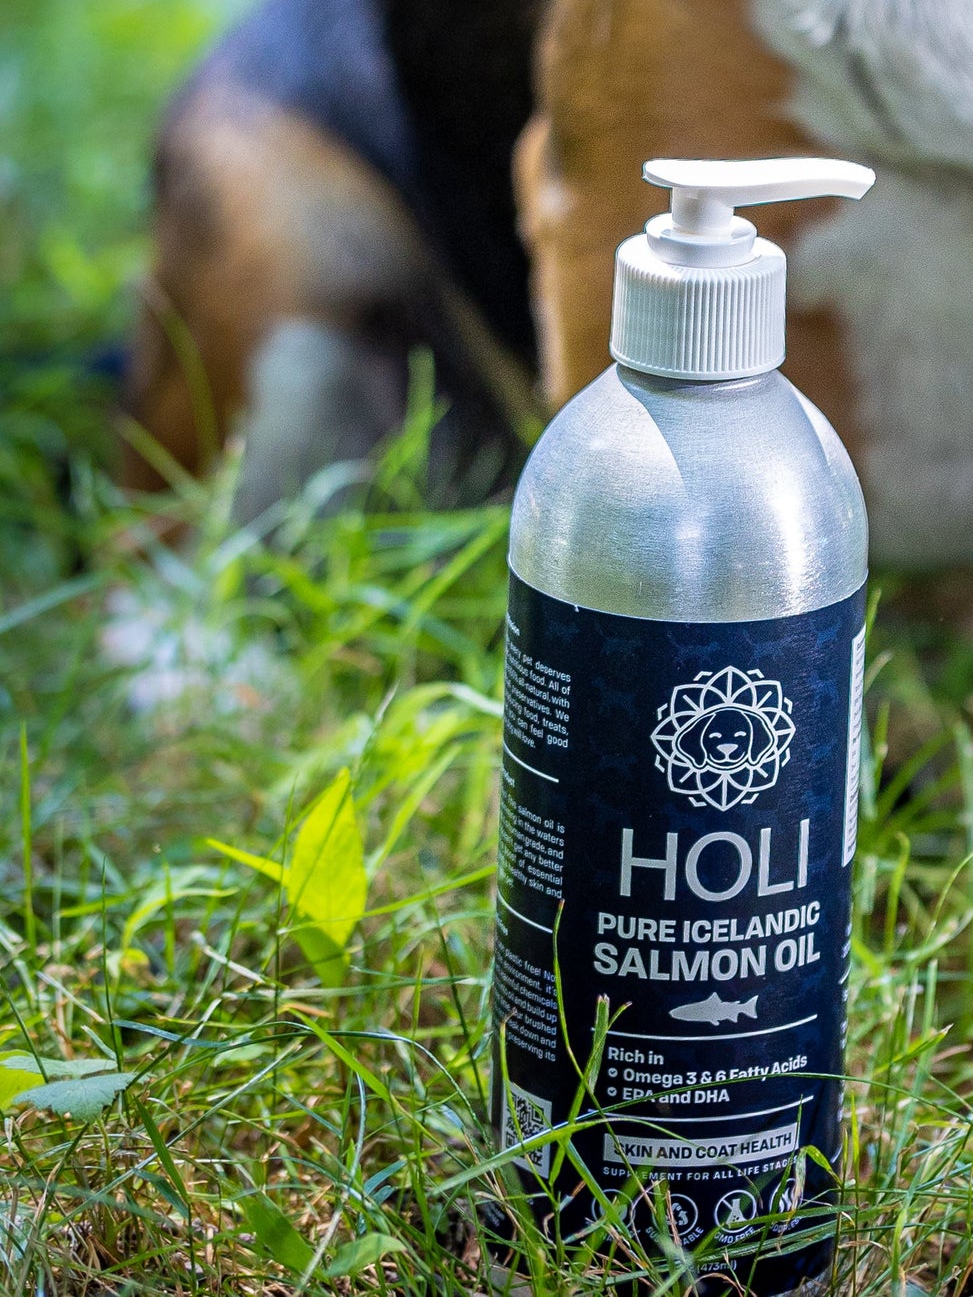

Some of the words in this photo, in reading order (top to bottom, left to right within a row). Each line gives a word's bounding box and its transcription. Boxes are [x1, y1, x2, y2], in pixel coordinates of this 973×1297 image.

[535, 660, 572, 682] deserves
[548, 680, 560, 692] All
[561, 685, 572, 695] of
[551, 695, 570, 709] with
[555, 708, 570, 722] We
[542, 717, 569, 736] treats,
[547, 734, 569, 748] good
[544, 819, 554, 830] oil
[557, 822, 566, 834] is
[536, 829, 565, 847] waters
[538, 854, 564, 872] better
[547, 847, 564, 860] and
[619, 818, 810, 902] HOLI
[527, 864, 563, 886] essential
[528, 878, 545, 892] skin
[546, 886, 563, 899] and
[597, 911, 677, 943] PURE
[683, 901, 821, 943] ICELANDIC
[593, 942, 767, 982] SALMON
[774, 932, 821, 972] OIL
[543, 969, 556, 982] No
[520, 986, 558, 1010] chemicals
[527, 1002, 546, 1018] build
[546, 1012, 558, 1023] up
[524, 1013, 557, 1036] brushed
[520, 1025, 540, 1042] down
[540, 1036, 557, 1049] and
[544, 1049, 556, 1062] its
[607, 1046, 645, 1064] Rich
[648, 1050, 664, 1065] in
[623, 1068, 683, 1088] Omega
[686, 1071, 697, 1085] 3
[700, 1071, 713, 1084] &
[715, 1070, 726, 1082] 6
[729, 1066, 769, 1081] Fatty
[771, 1055, 808, 1075] Acids
[623, 1087, 655, 1102] EPA
[659, 1090, 692, 1104] and
[694, 1089, 730, 1104] DHA
[613, 1143, 653, 1158] SKIN
[656, 1145, 692, 1160] AND
[695, 1144, 738, 1160] COAT
[740, 1132, 792, 1156] HEALTH
[687, 1171, 709, 1181] FOR
[713, 1169, 734, 1180] ALL
[737, 1166, 760, 1177] LIFE
